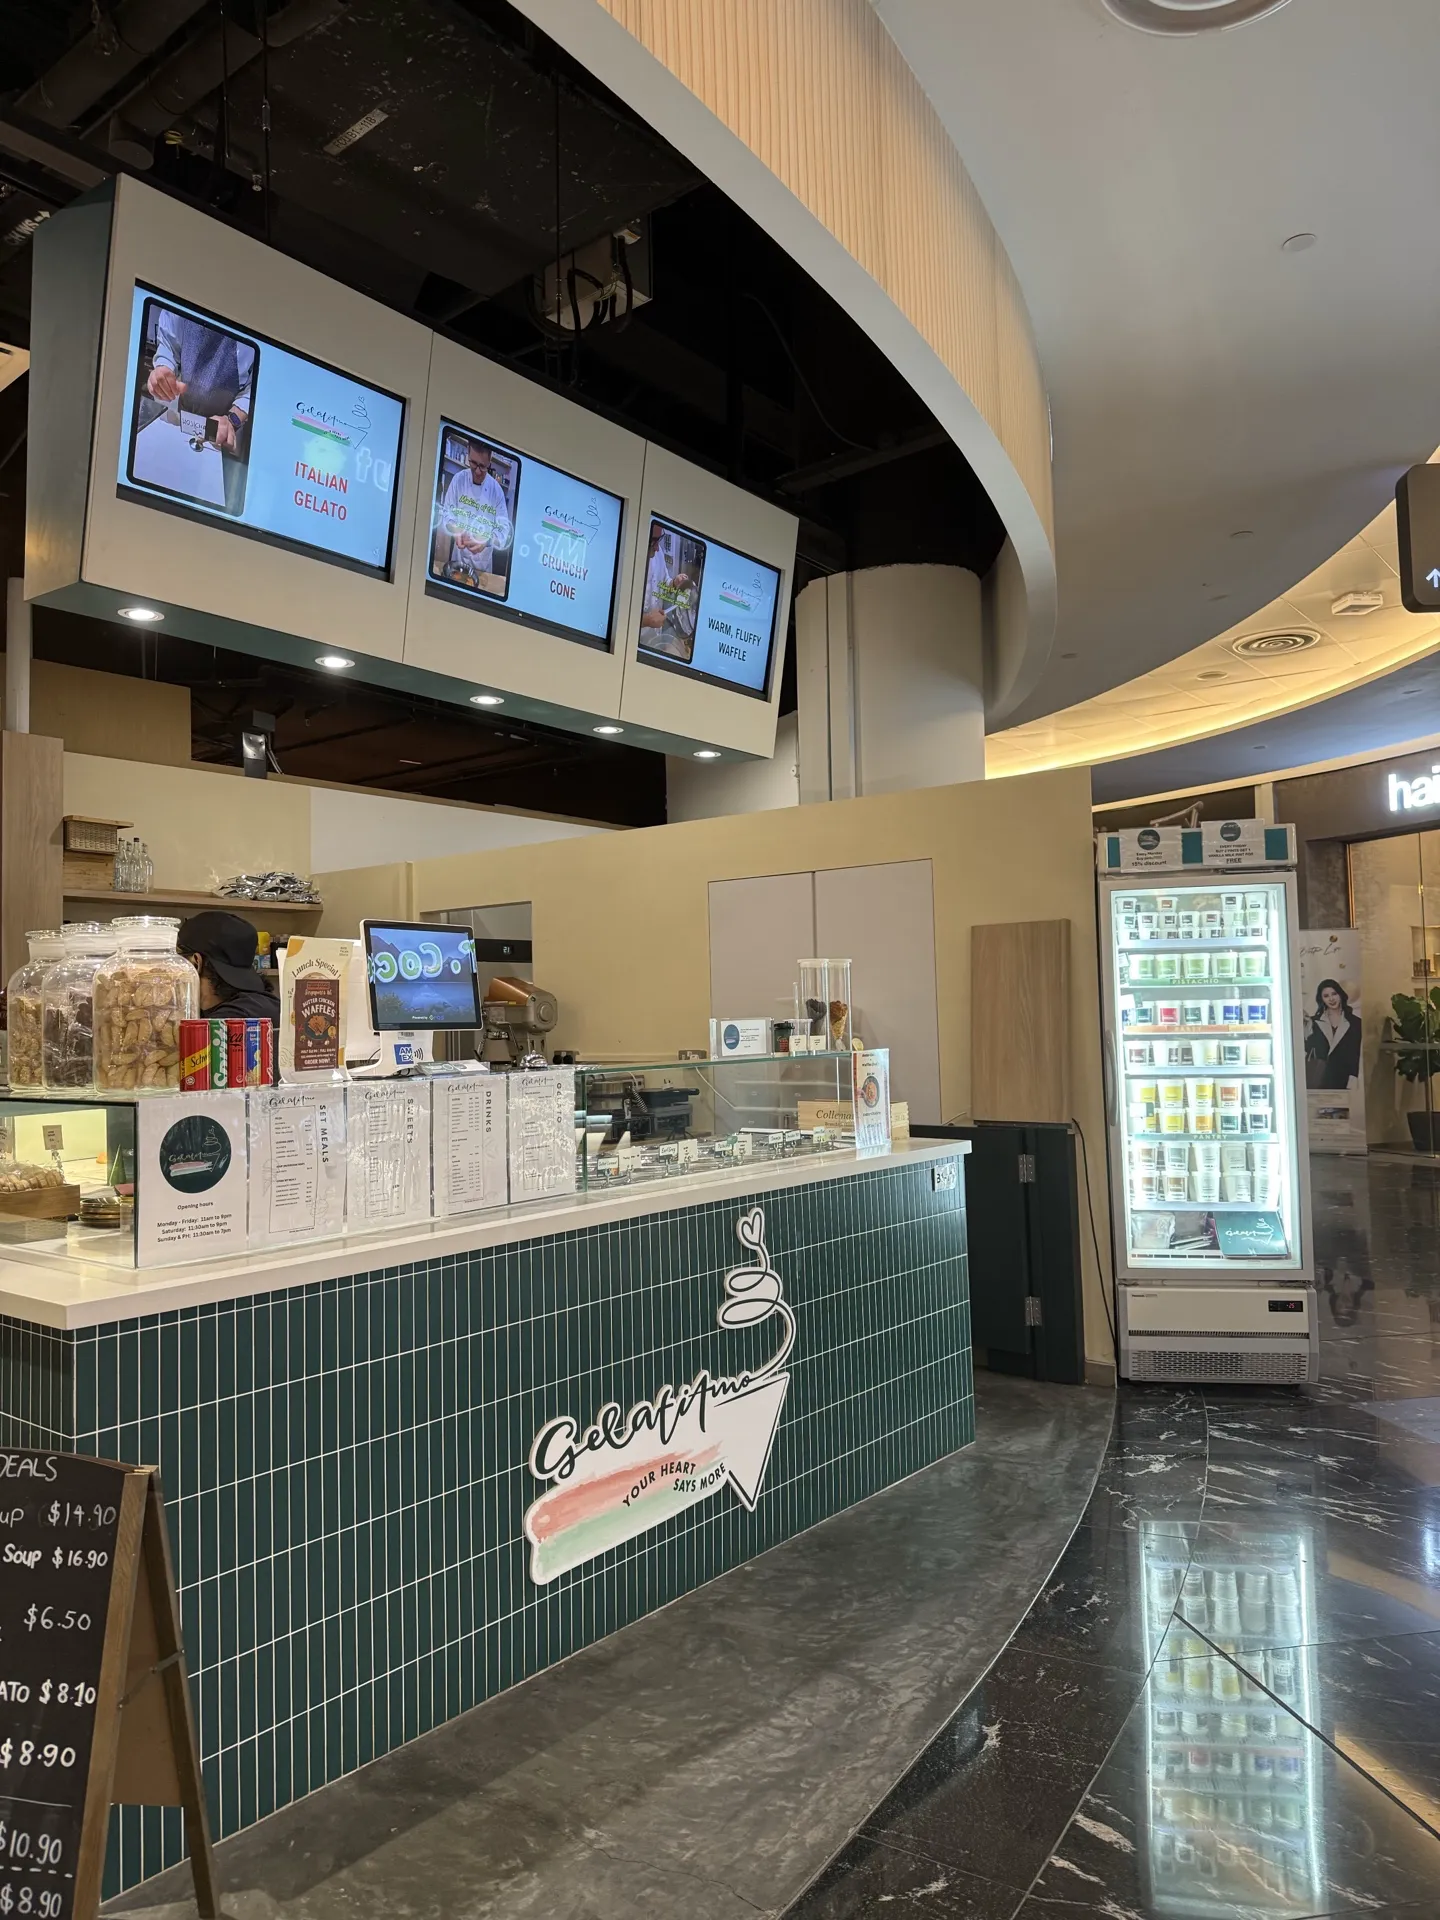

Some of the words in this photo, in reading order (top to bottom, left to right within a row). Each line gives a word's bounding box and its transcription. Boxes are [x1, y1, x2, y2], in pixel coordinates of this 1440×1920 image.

[294, 461, 348, 494] ITALIAN
[293, 490, 347, 521] GELATO
[541, 553, 589, 582] CRUNCHY
[549, 579, 577, 601] CONE
[708, 617, 734, 639] WARM,
[735, 628, 762, 647] FLUFFY
[718, 641, 747, 662] WAFFLE
[291, 959, 314, 978] Lunch
[315, 958, 338, 976] Special
[301, 1004, 336, 1019] WAFFLES
[318, 997, 336, 1007] CHICKEN
[319, 1104, 327, 1123] SET
[406, 1098, 414, 1144] SWEETS
[320, 1128, 329, 1163] MEALS
[177, 1202, 199, 1210] Opening
[157, 1220, 178, 1228] Monday
[181, 1217, 199, 1226] Friday:
[161, 1226, 187, 1235] Saturday:
[157, 1234, 177, 1243] Sunday
[621, 1471, 656, 1508] YOUR
[660, 1460, 697, 1476] HEART
[672, 1477, 697, 1492] SAYS
[699, 1462, 727, 1490] MORE
[2, 1543, 43, 1570] Soup
[23, 1603, 92, 1632] $6.50
